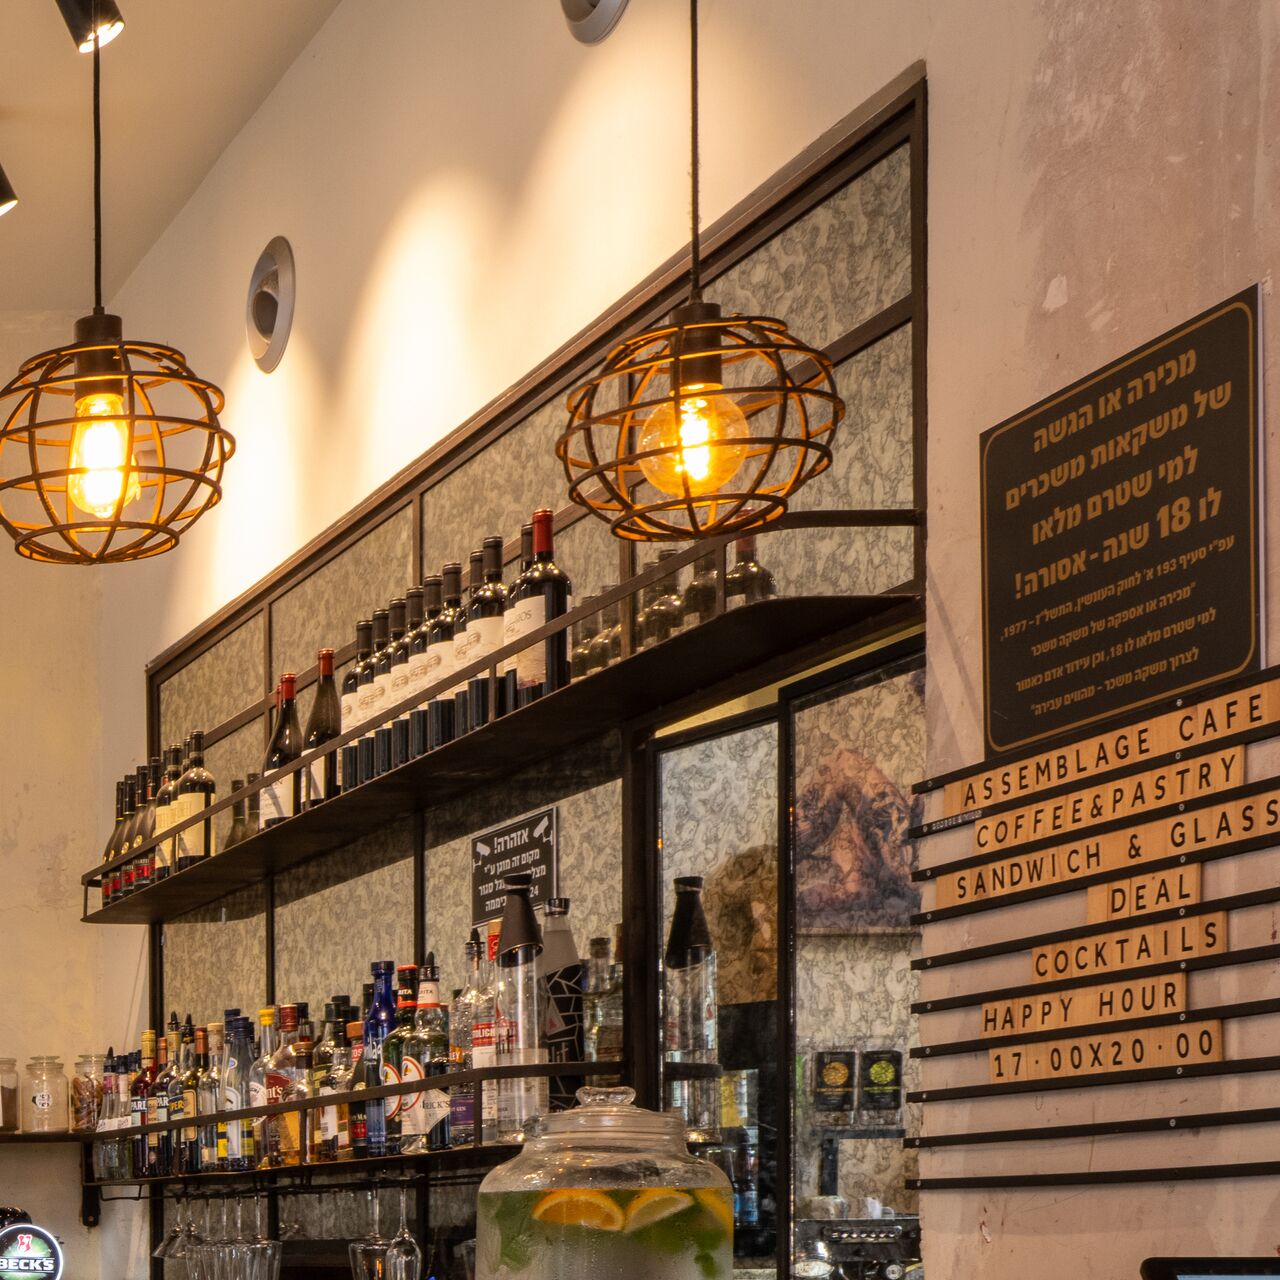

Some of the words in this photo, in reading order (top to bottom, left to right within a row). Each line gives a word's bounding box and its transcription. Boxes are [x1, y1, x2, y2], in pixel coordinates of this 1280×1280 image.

[1127, 349, 1197, 405] מכירה
[1098, 387, 1123, 420] או
[1193, 381, 1232, 418] של
[1033, 405, 1093, 453] הגשה
[1090, 402, 1189, 469] משקאות
[1158, 444, 1198, 484] למי
[1005, 454, 1086, 511] משכרים
[1087, 469, 1153, 520] שטרם
[1156, 497, 1190, 539] 18
[1199, 486, 1222, 522] לו
[1032, 502, 1082, 545] מלאו
[1103, 522, 1149, 563] שנה
[1179, 547, 1207, 570] סעיף
[1117, 571, 1142, 596] לחוק
[1156, 558, 1177, 577] 193
[1107, 605, 1144, 628] אספקה
[1146, 599, 1158, 613] או
[1197, 607, 1217, 625] למי
[1058, 625, 1089, 648] משקה
[1091, 618, 1106, 634] של
[1136, 629, 1161, 649] מלאו
[1163, 617, 1195, 639] שטרם
[1125, 638, 1135, 653] לו
[964, 728, 1151, 806] ASSEMBLAGE
[1178, 693, 1263, 741] CAFE
[976, 754, 1236, 848] COFFEE&PASTRY
[494, 828, 529, 854] אזהרה!
[521, 849, 539, 864] מקום
[957, 842, 1102, 899] SANDWICH
[1128, 833, 1142, 860] &
[1170, 799, 1279, 848] GLASS
[512, 856, 520, 867] זה
[530, 885, 539, 897] 24
[1111, 874, 1190, 914] DEAL
[1035, 922, 1217, 977] COCKTAILS
[984, 997, 1072, 1032] HAPPY
[1099, 982, 1176, 1016] HOUR
